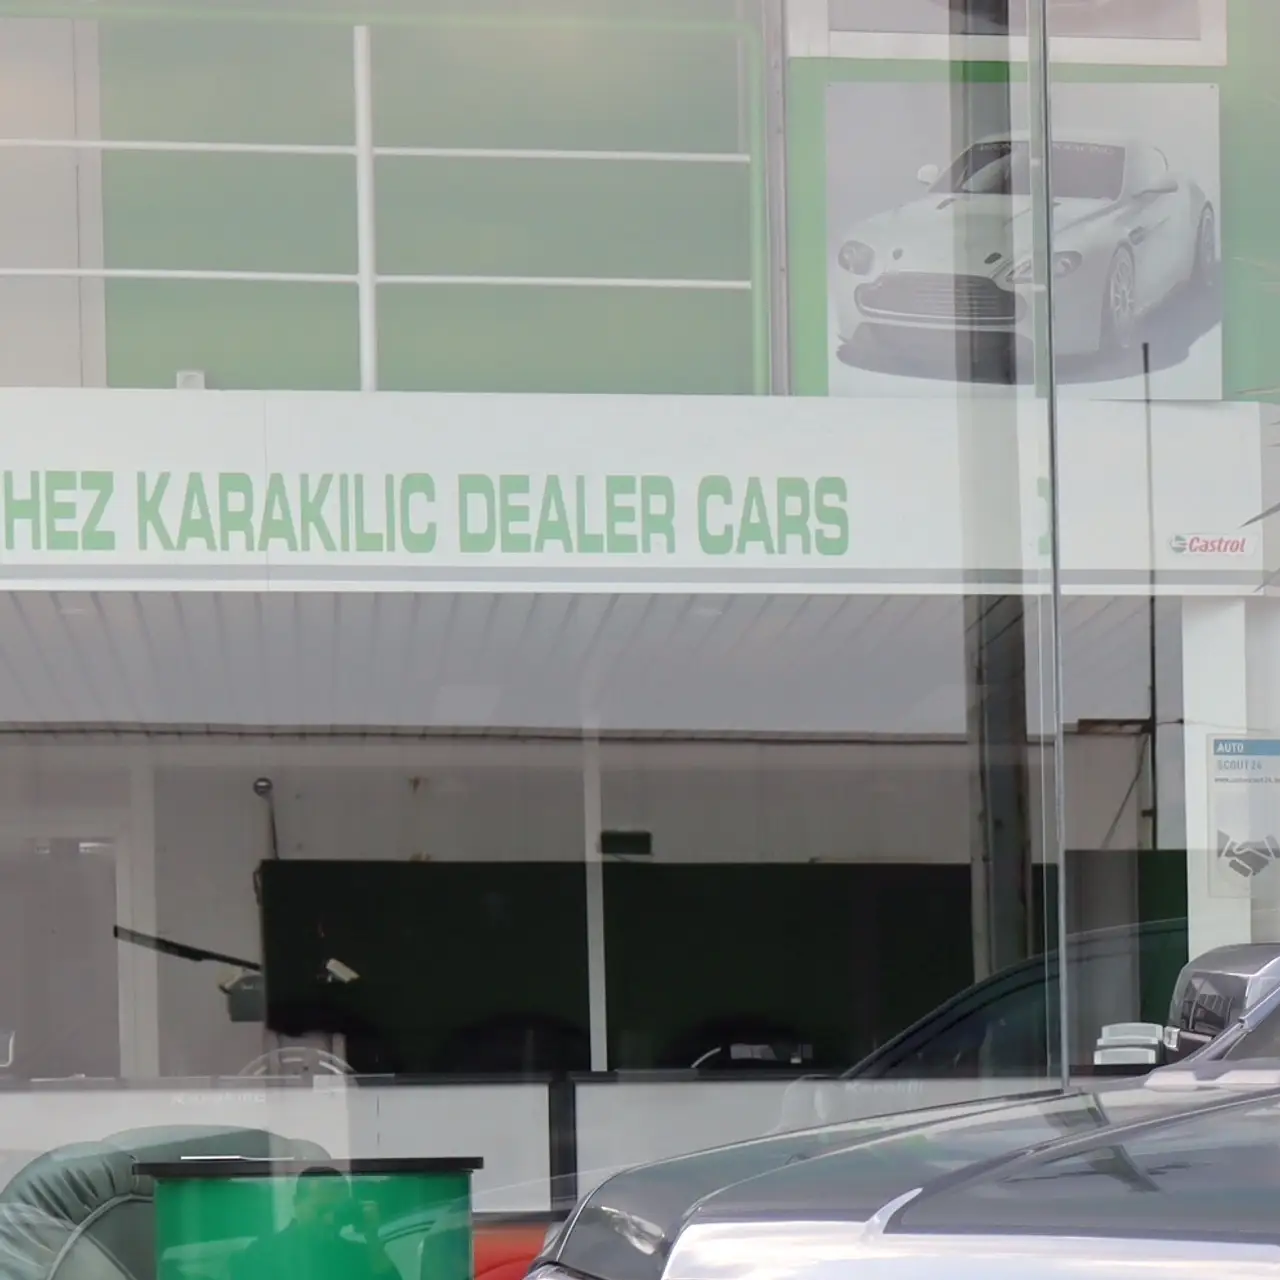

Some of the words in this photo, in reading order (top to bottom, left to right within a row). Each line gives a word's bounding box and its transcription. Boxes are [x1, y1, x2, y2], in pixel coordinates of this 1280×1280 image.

[3, 470, 116, 551] HEZ
[136, 471, 437, 553] KARAKILIC
[457, 473, 676, 554] DEALER
[697, 475, 850, 556] CARS
[1188, 536, 1246, 553] Castrol
[1216, 742, 1244, 754] AUTO
